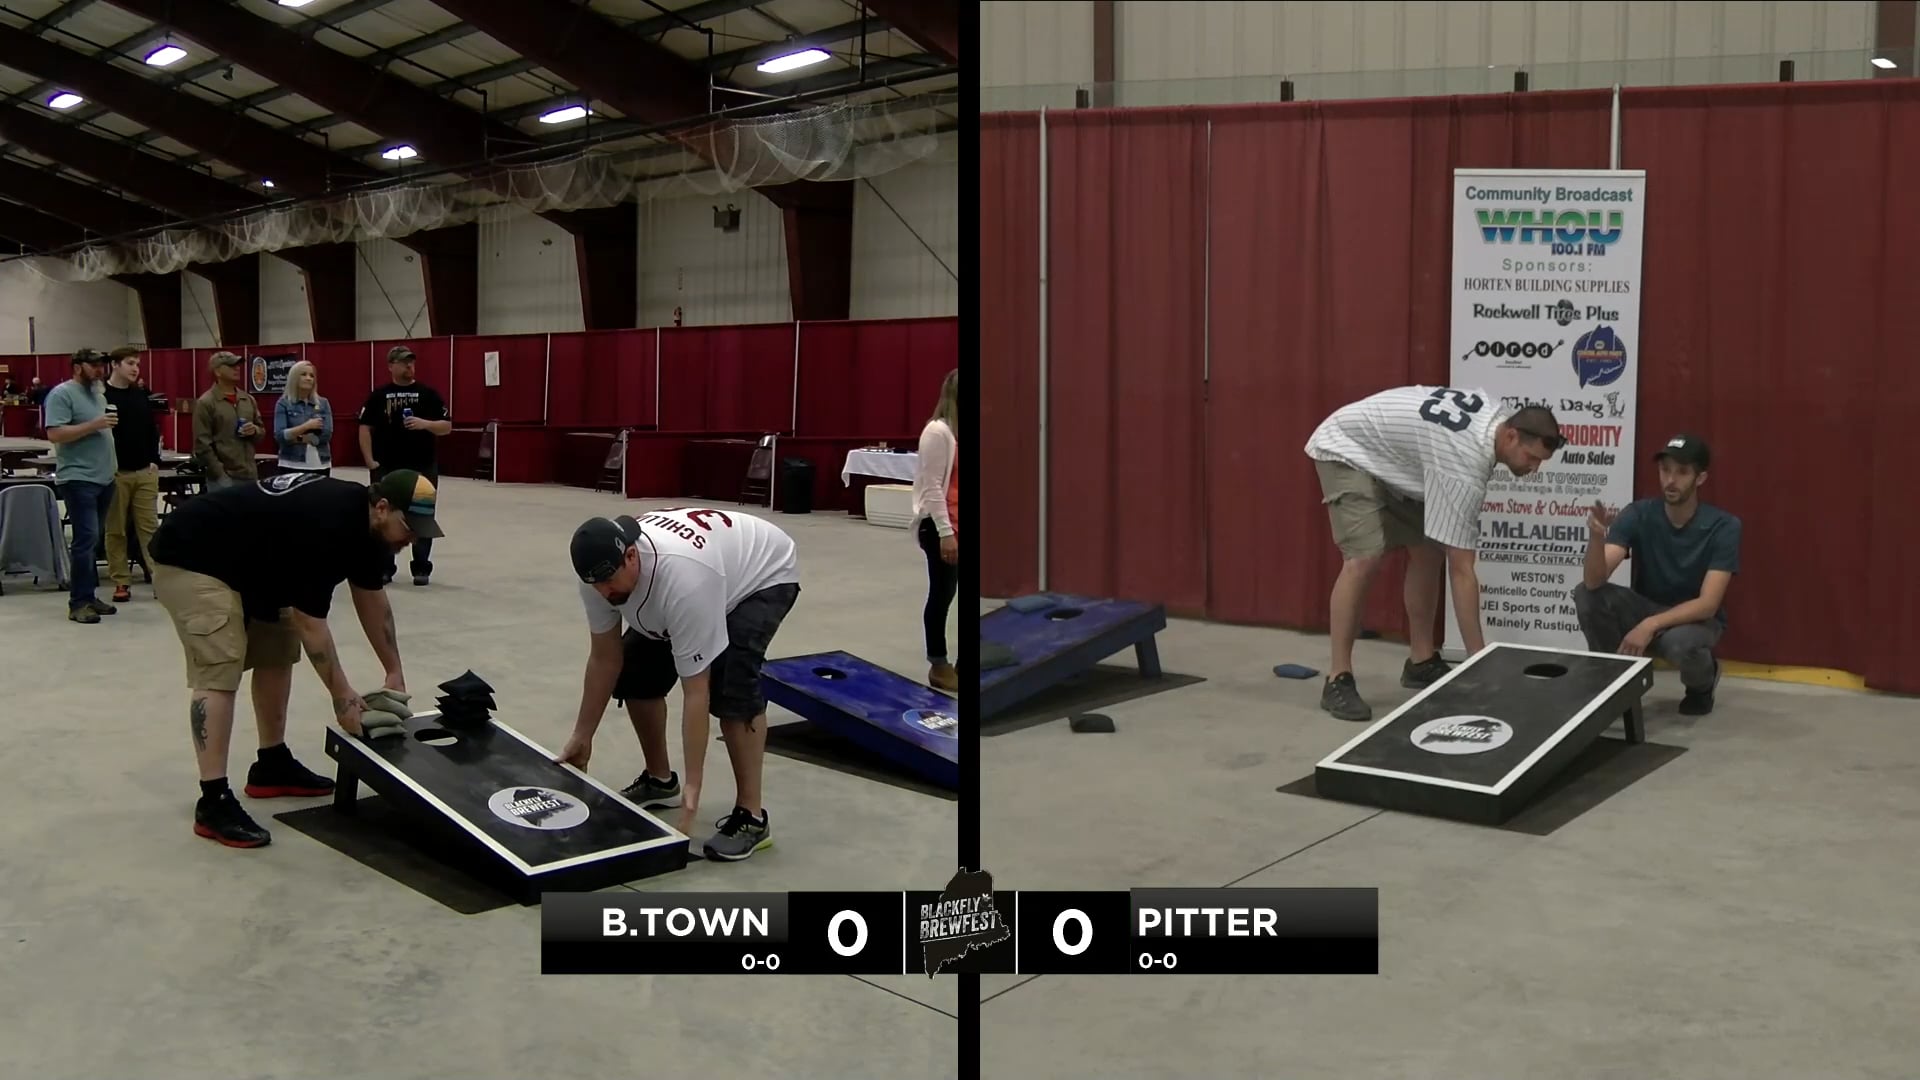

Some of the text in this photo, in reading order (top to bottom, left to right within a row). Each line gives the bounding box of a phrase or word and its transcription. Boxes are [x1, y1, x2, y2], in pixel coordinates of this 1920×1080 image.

[1466, 186, 1633, 204] Community Broadcast
[1474, 208, 1624, 244] WHOU
[1551, 243, 1606, 256] 100.1 FM
[1502, 258, 1593, 274] Sponsors:
[1464, 277, 1630, 294] HORTEN BUILDING SUPPLIES
[1473, 303, 1620, 321] Rockwell Tires Plus
[1561, 451, 1615, 465] Auto Sales
[1546, 472, 1608, 485] TOWING
[1506, 498, 1532, 515] Stove
[1535, 500, 1547, 515] &
[1491, 520, 1589, 542] McLAUGHL
[1580, 544, 1588, 554] L
[1511, 571, 1565, 584] WESTON'S
[1480, 584, 1577, 600] Monticello Country S
[1481, 601, 1576, 616] JEI Sports of Ma
[1487, 617, 1530, 631] Mainely
[510, 800, 561, 816] BREWFEST
